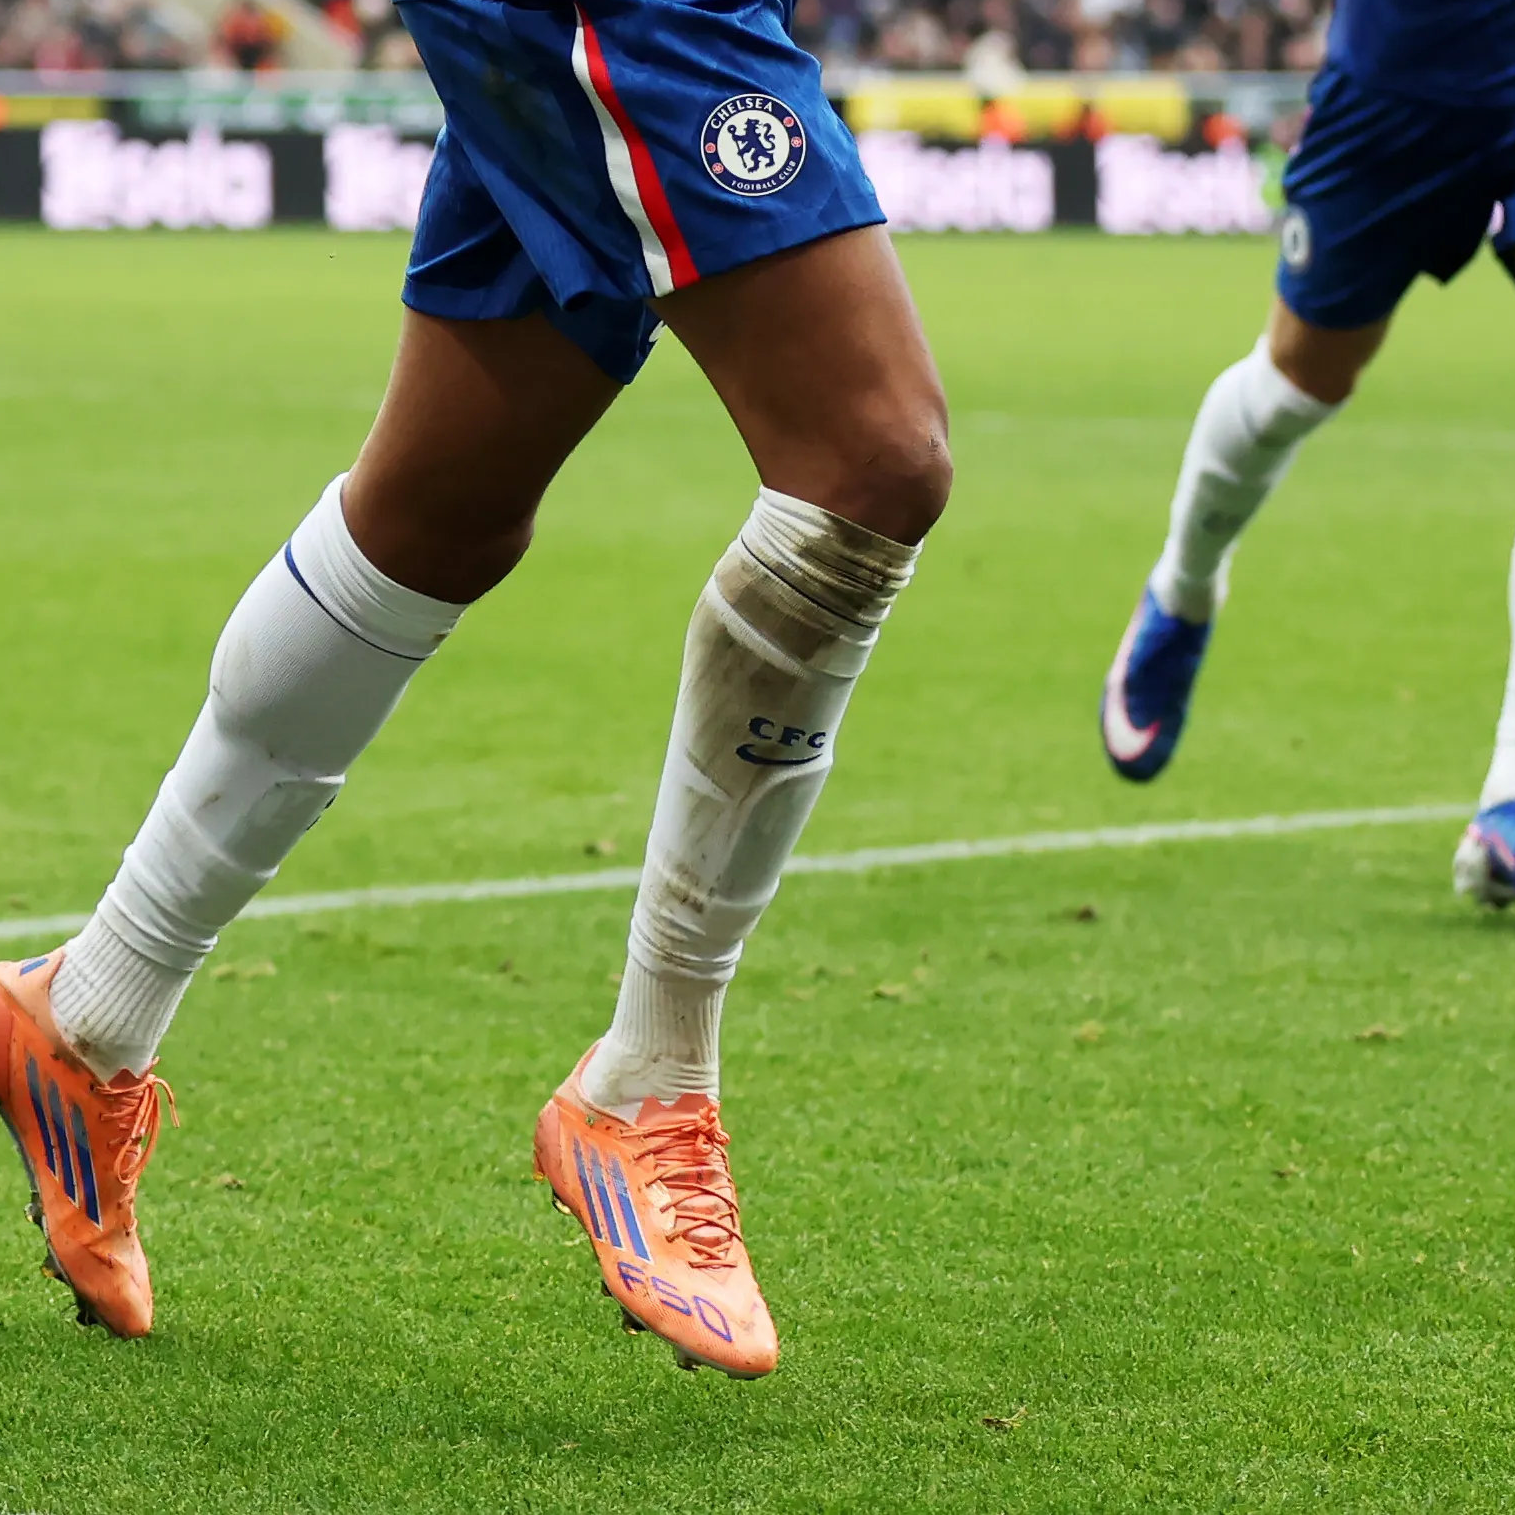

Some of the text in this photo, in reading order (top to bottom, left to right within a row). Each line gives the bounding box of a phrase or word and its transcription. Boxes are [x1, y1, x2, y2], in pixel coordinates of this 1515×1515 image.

[711, 98, 773, 129] CHELSEA
[731, 160, 797, 191] FOOTBALL CLUB
[748, 716, 826, 749] CFC
[617, 1261, 733, 1343] F50
